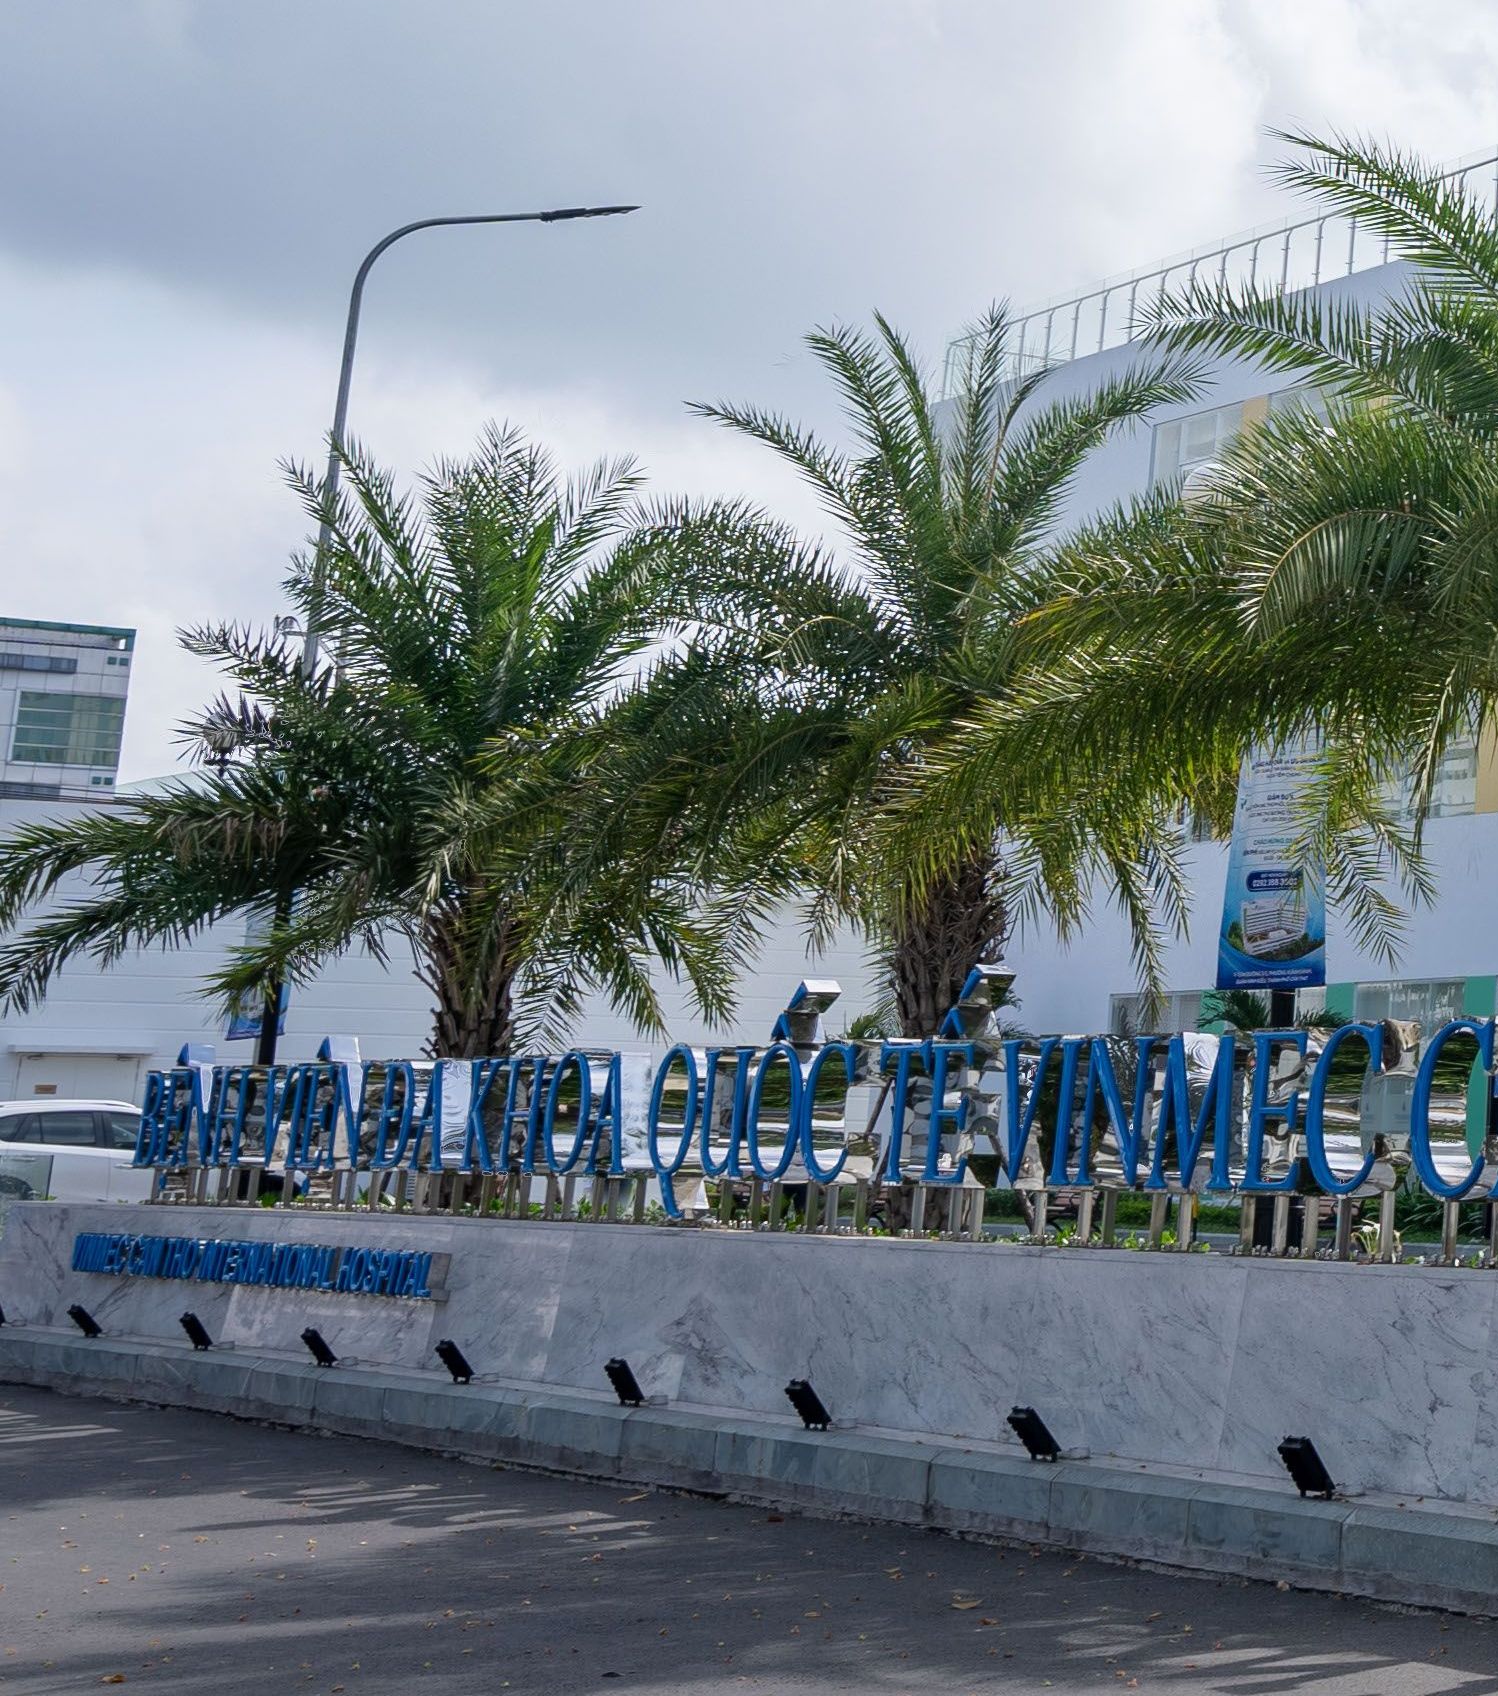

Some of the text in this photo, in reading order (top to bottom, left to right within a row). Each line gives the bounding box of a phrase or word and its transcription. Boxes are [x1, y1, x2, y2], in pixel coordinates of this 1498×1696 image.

[370, 1059, 445, 1172] ĐA
[462, 1050, 625, 1176] KHOA
[648, 979, 858, 1219] QUỐC
[880, 965, 981, 1185] TẾ
[1001, 1022, 1385, 1196] VINMEC
[336, 1246, 433, 1299] HOSPITAL
